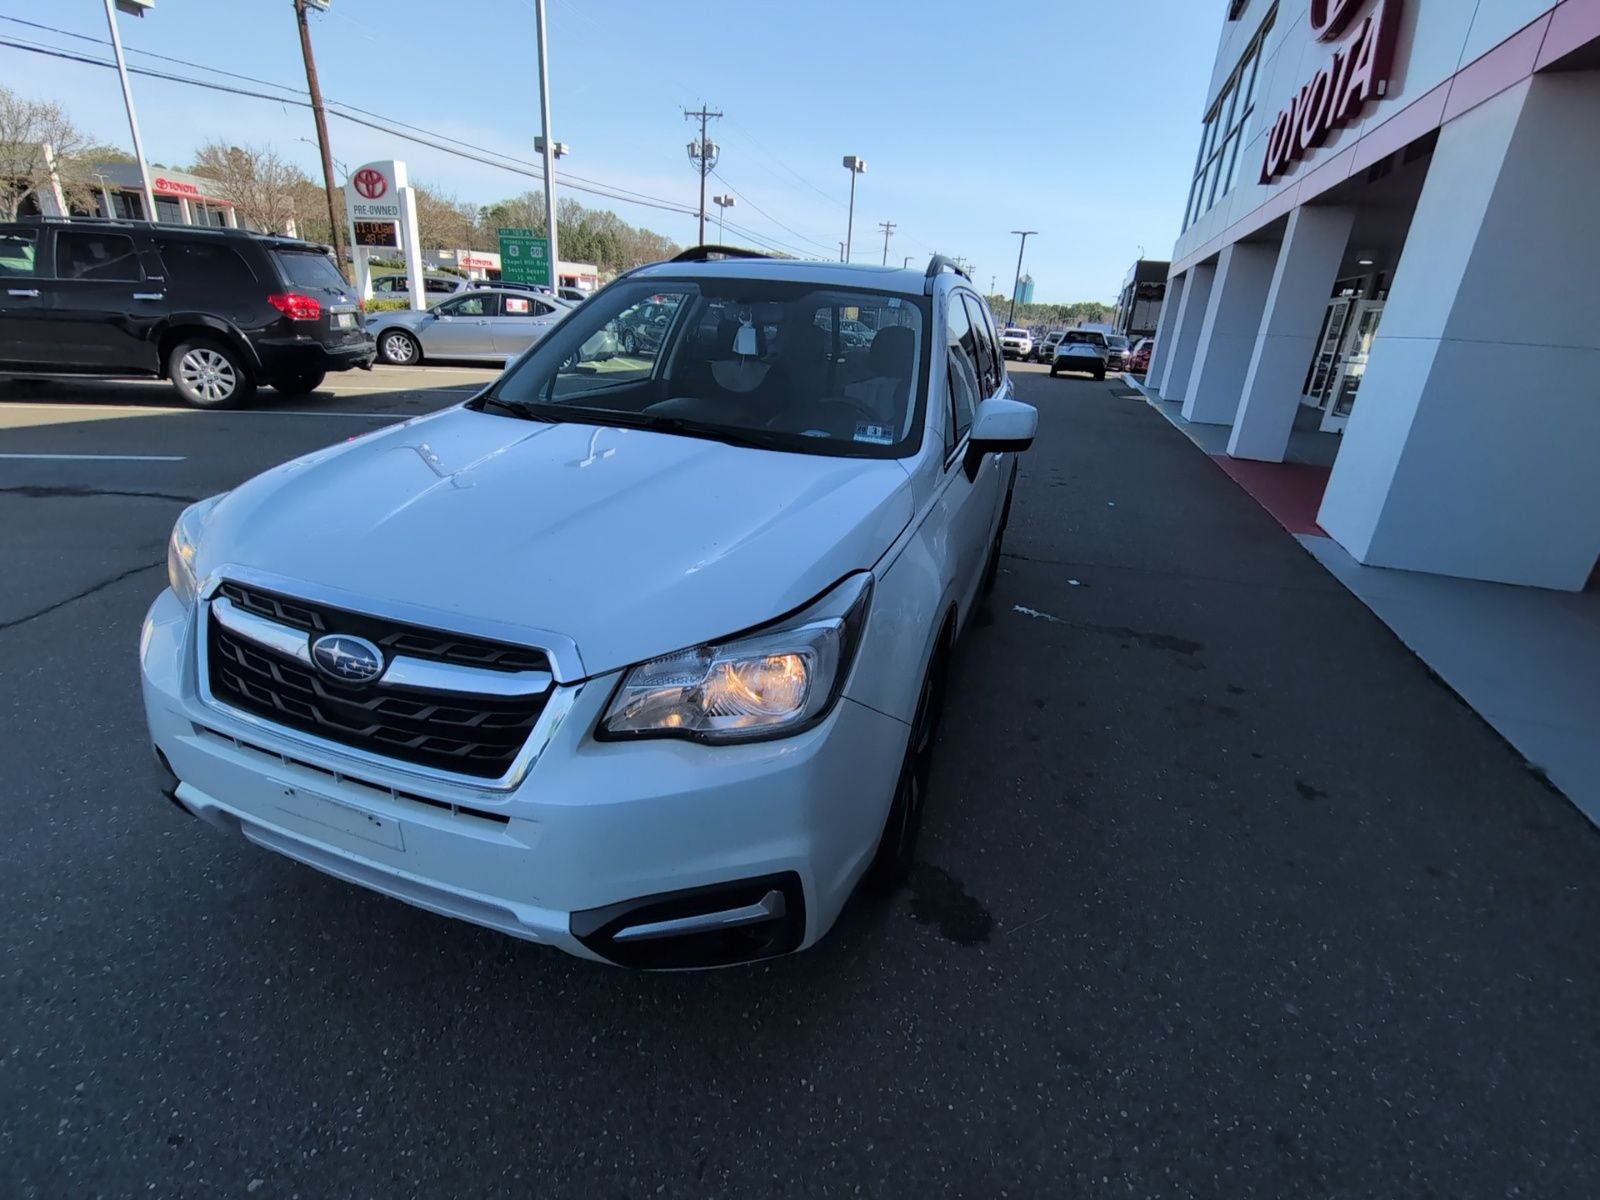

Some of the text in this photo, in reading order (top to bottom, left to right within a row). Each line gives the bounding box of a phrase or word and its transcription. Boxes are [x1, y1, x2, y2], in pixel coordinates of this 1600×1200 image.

[167, 181, 199, 194] TOYOTA
[353, 204, 398, 216] PRE-OWNED
[504, 258, 523, 266] Chapel
[524, 259, 535, 267] Hill
